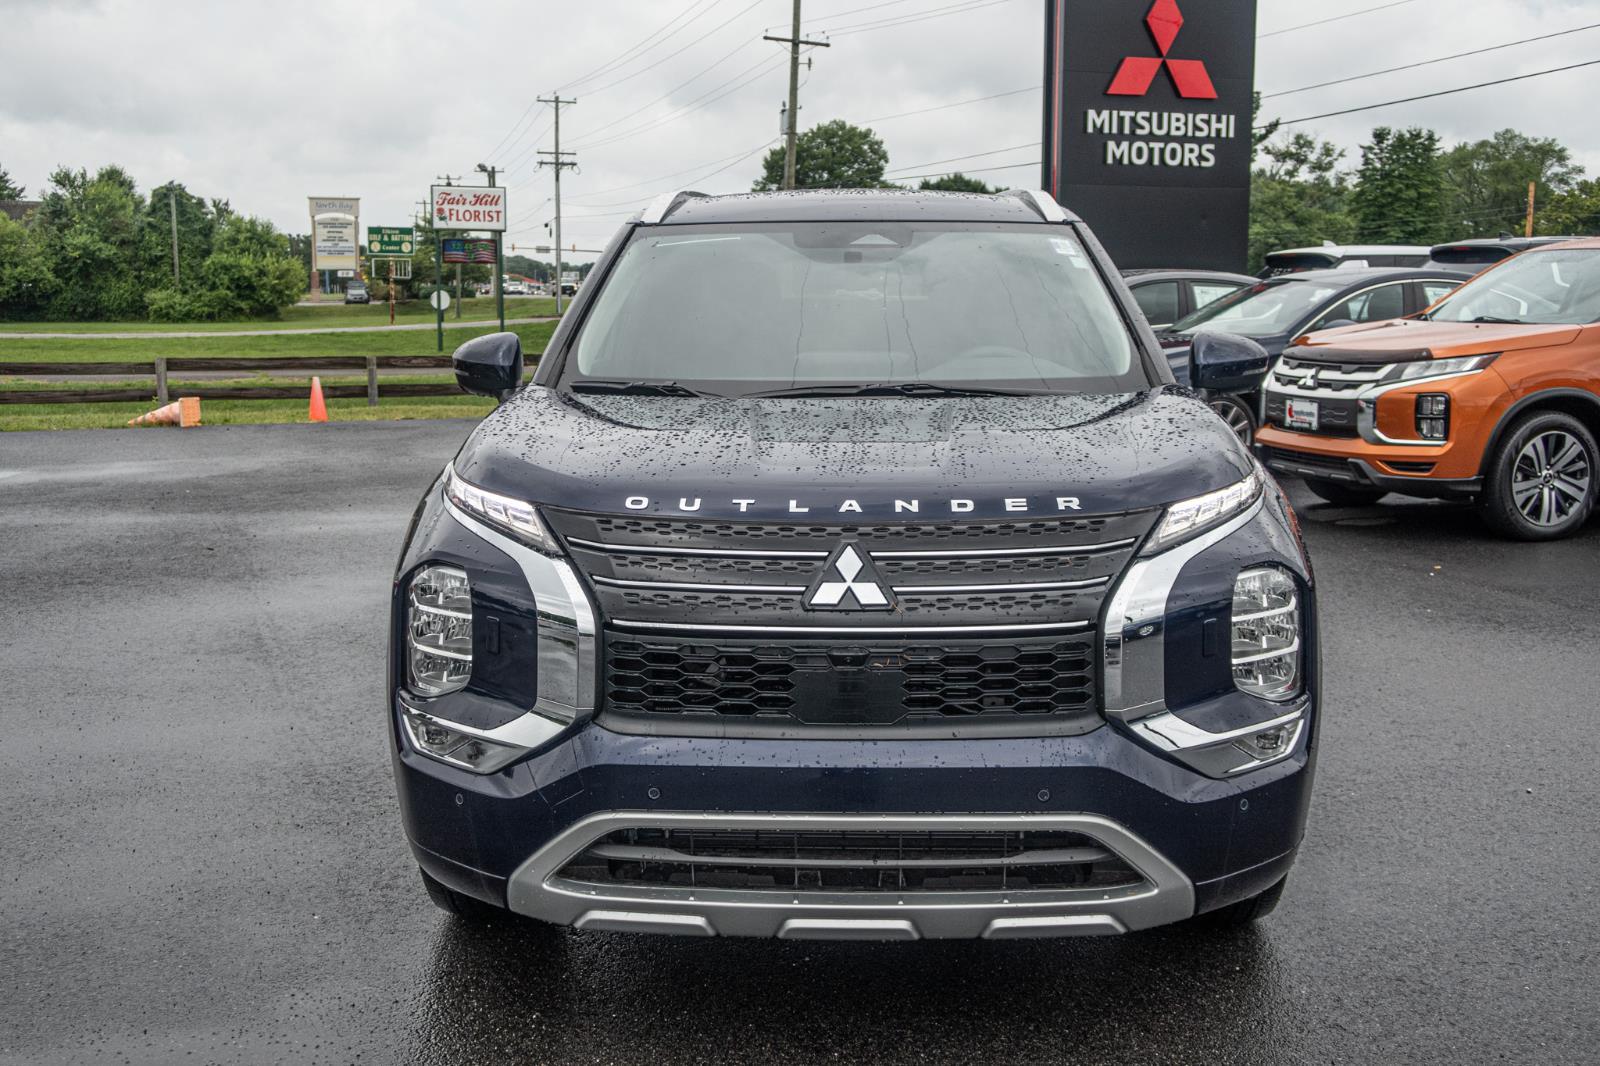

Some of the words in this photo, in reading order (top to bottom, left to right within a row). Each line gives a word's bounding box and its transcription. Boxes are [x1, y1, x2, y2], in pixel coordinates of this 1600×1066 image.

[1086, 109, 1236, 138] MITSUBISHI
[1106, 140, 1216, 167] MOTORS
[436, 192, 467, 206] Fair
[469, 193, 500, 206] Hill
[448, 208, 502, 223] FLORIST
[624, 495, 1081, 513] OUTLANDER
